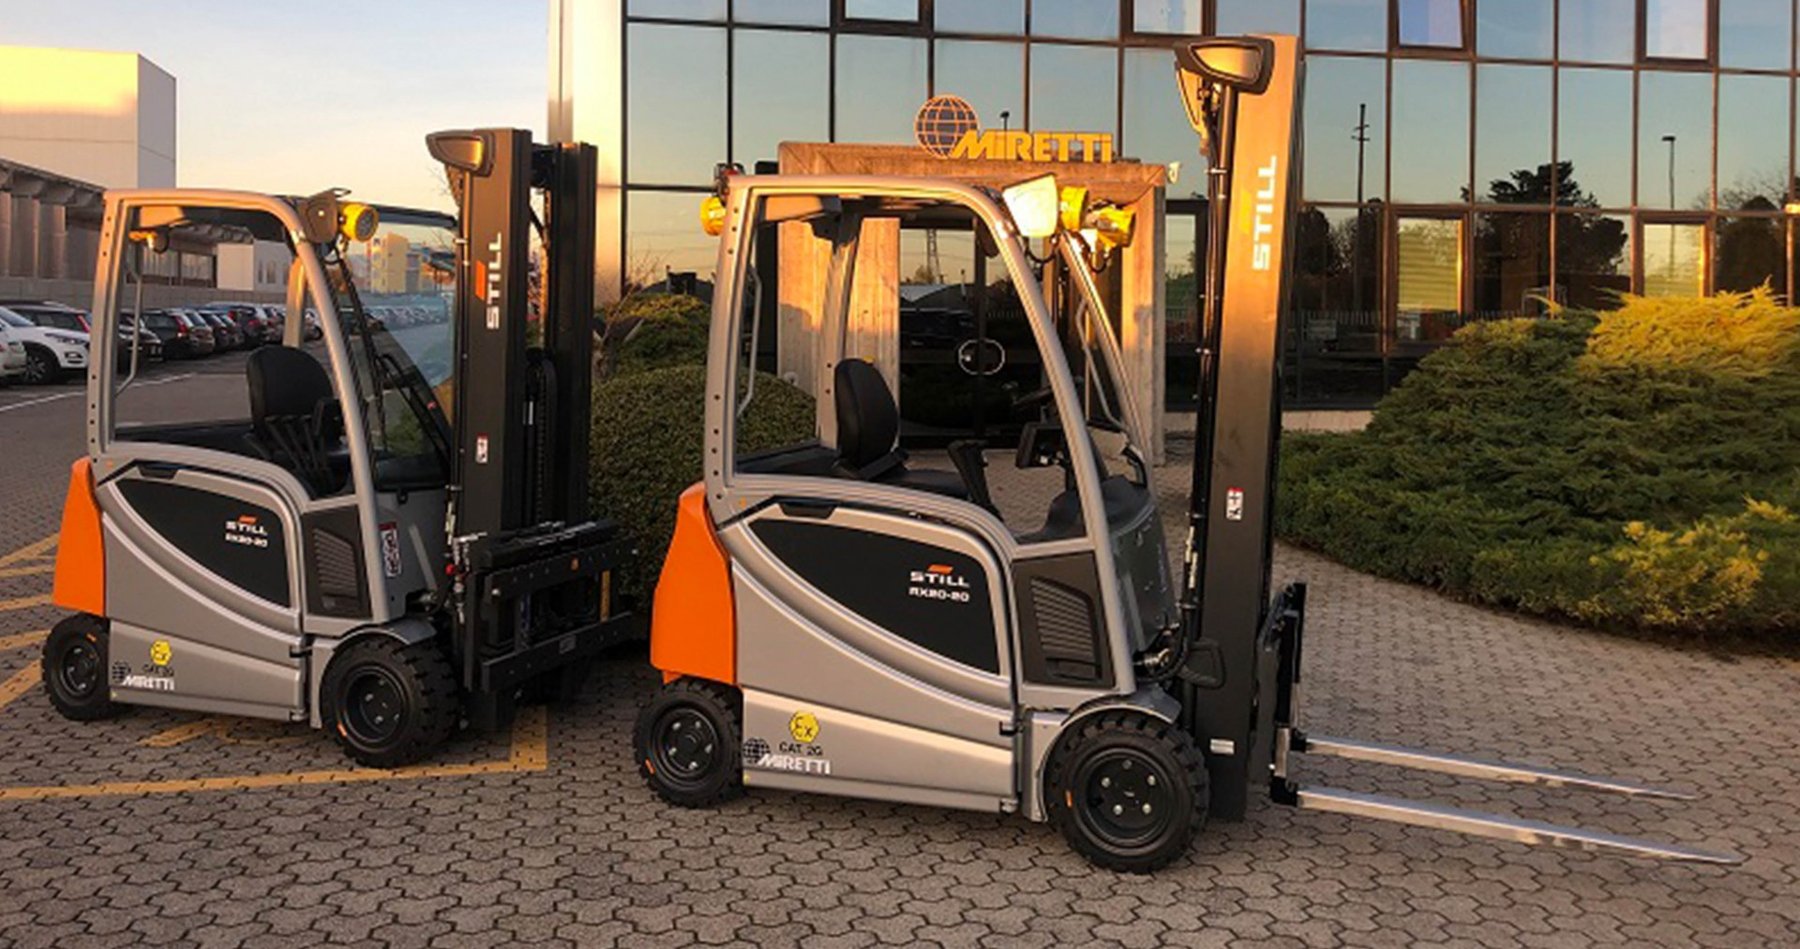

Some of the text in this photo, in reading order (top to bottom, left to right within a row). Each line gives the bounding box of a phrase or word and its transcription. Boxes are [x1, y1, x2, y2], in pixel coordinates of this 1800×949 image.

[1252, 155, 1277, 271] STILL
[486, 232, 501, 330] STILL
[910, 571, 970, 588] STILL
[909, 587, 970, 602] RX20-20
[794, 716, 812, 738] Ex
